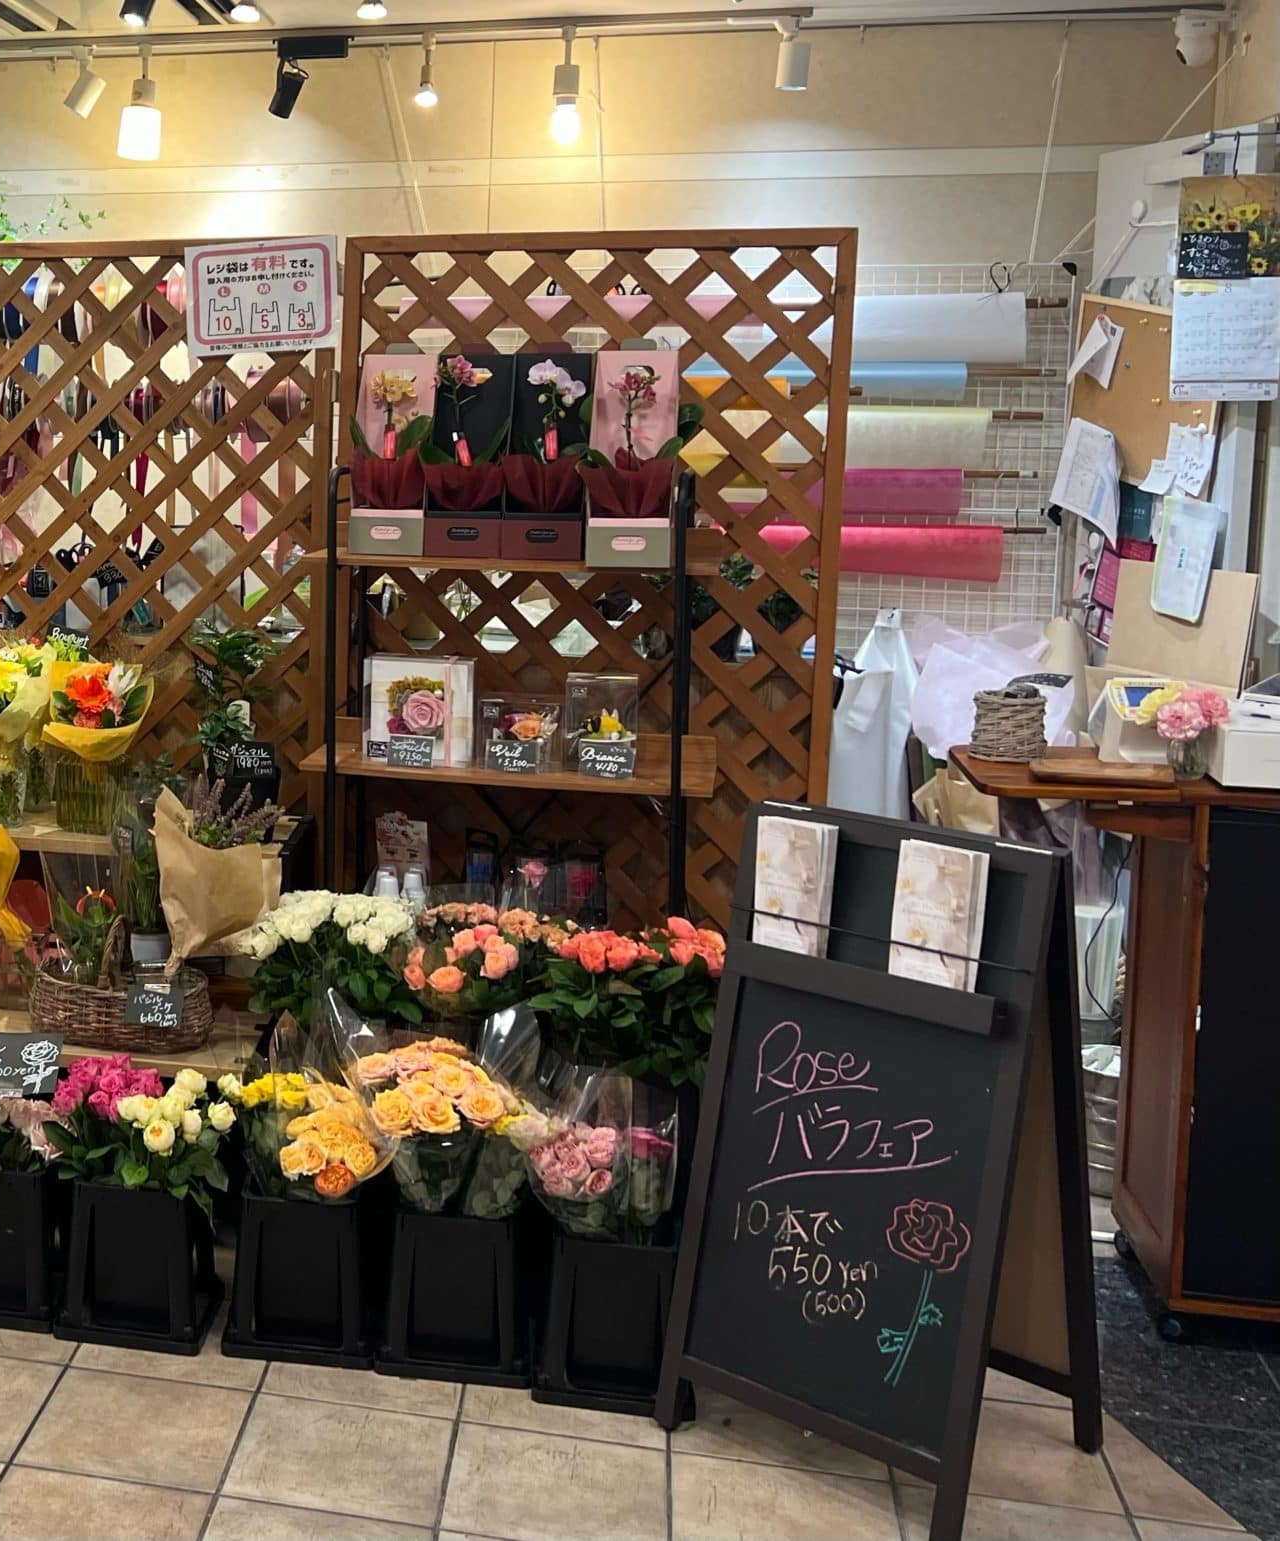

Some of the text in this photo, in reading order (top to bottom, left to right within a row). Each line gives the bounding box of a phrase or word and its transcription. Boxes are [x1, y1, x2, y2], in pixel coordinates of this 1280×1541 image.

[207, 254, 315, 275] レジ袋は有料です。
[53, 627, 90, 650] Bouquet
[236, 757, 260, 769] 1980
[581, 747, 627, 763] Bianca
[133, 993, 163, 1005] バジル
[151, 1002, 173, 1014] ブーケ
[140, 1012, 162, 1024] 660
[755, 1021, 870, 1094] Rose
[768, 1101, 934, 1168] バラフェア
[768, 1246, 831, 1286] 550
[801, 1287, 866, 1323] (500)
